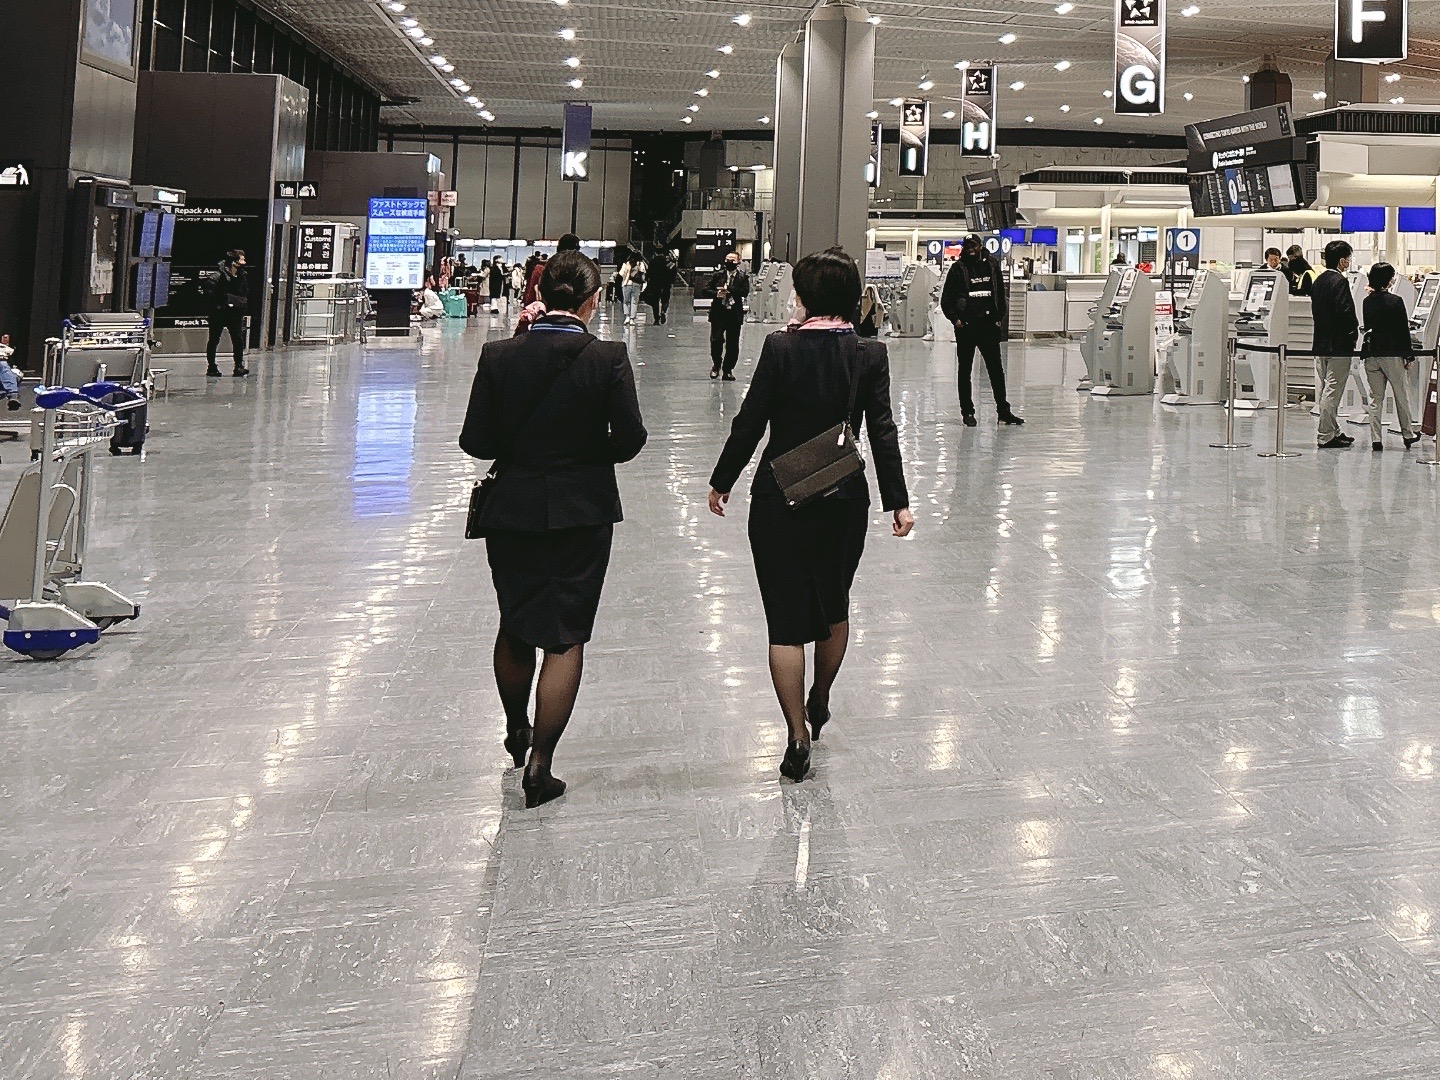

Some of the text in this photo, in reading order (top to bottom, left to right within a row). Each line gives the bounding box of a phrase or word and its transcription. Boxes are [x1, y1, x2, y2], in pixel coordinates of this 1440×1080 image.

[1119, 64, 1155, 104] G
[963, 121, 989, 150] H
[565, 151, 588, 178] K
[906, 147, 917, 172] I
[174, 207, 202, 215] Repack
[1183, 234, 1189, 247] 1
